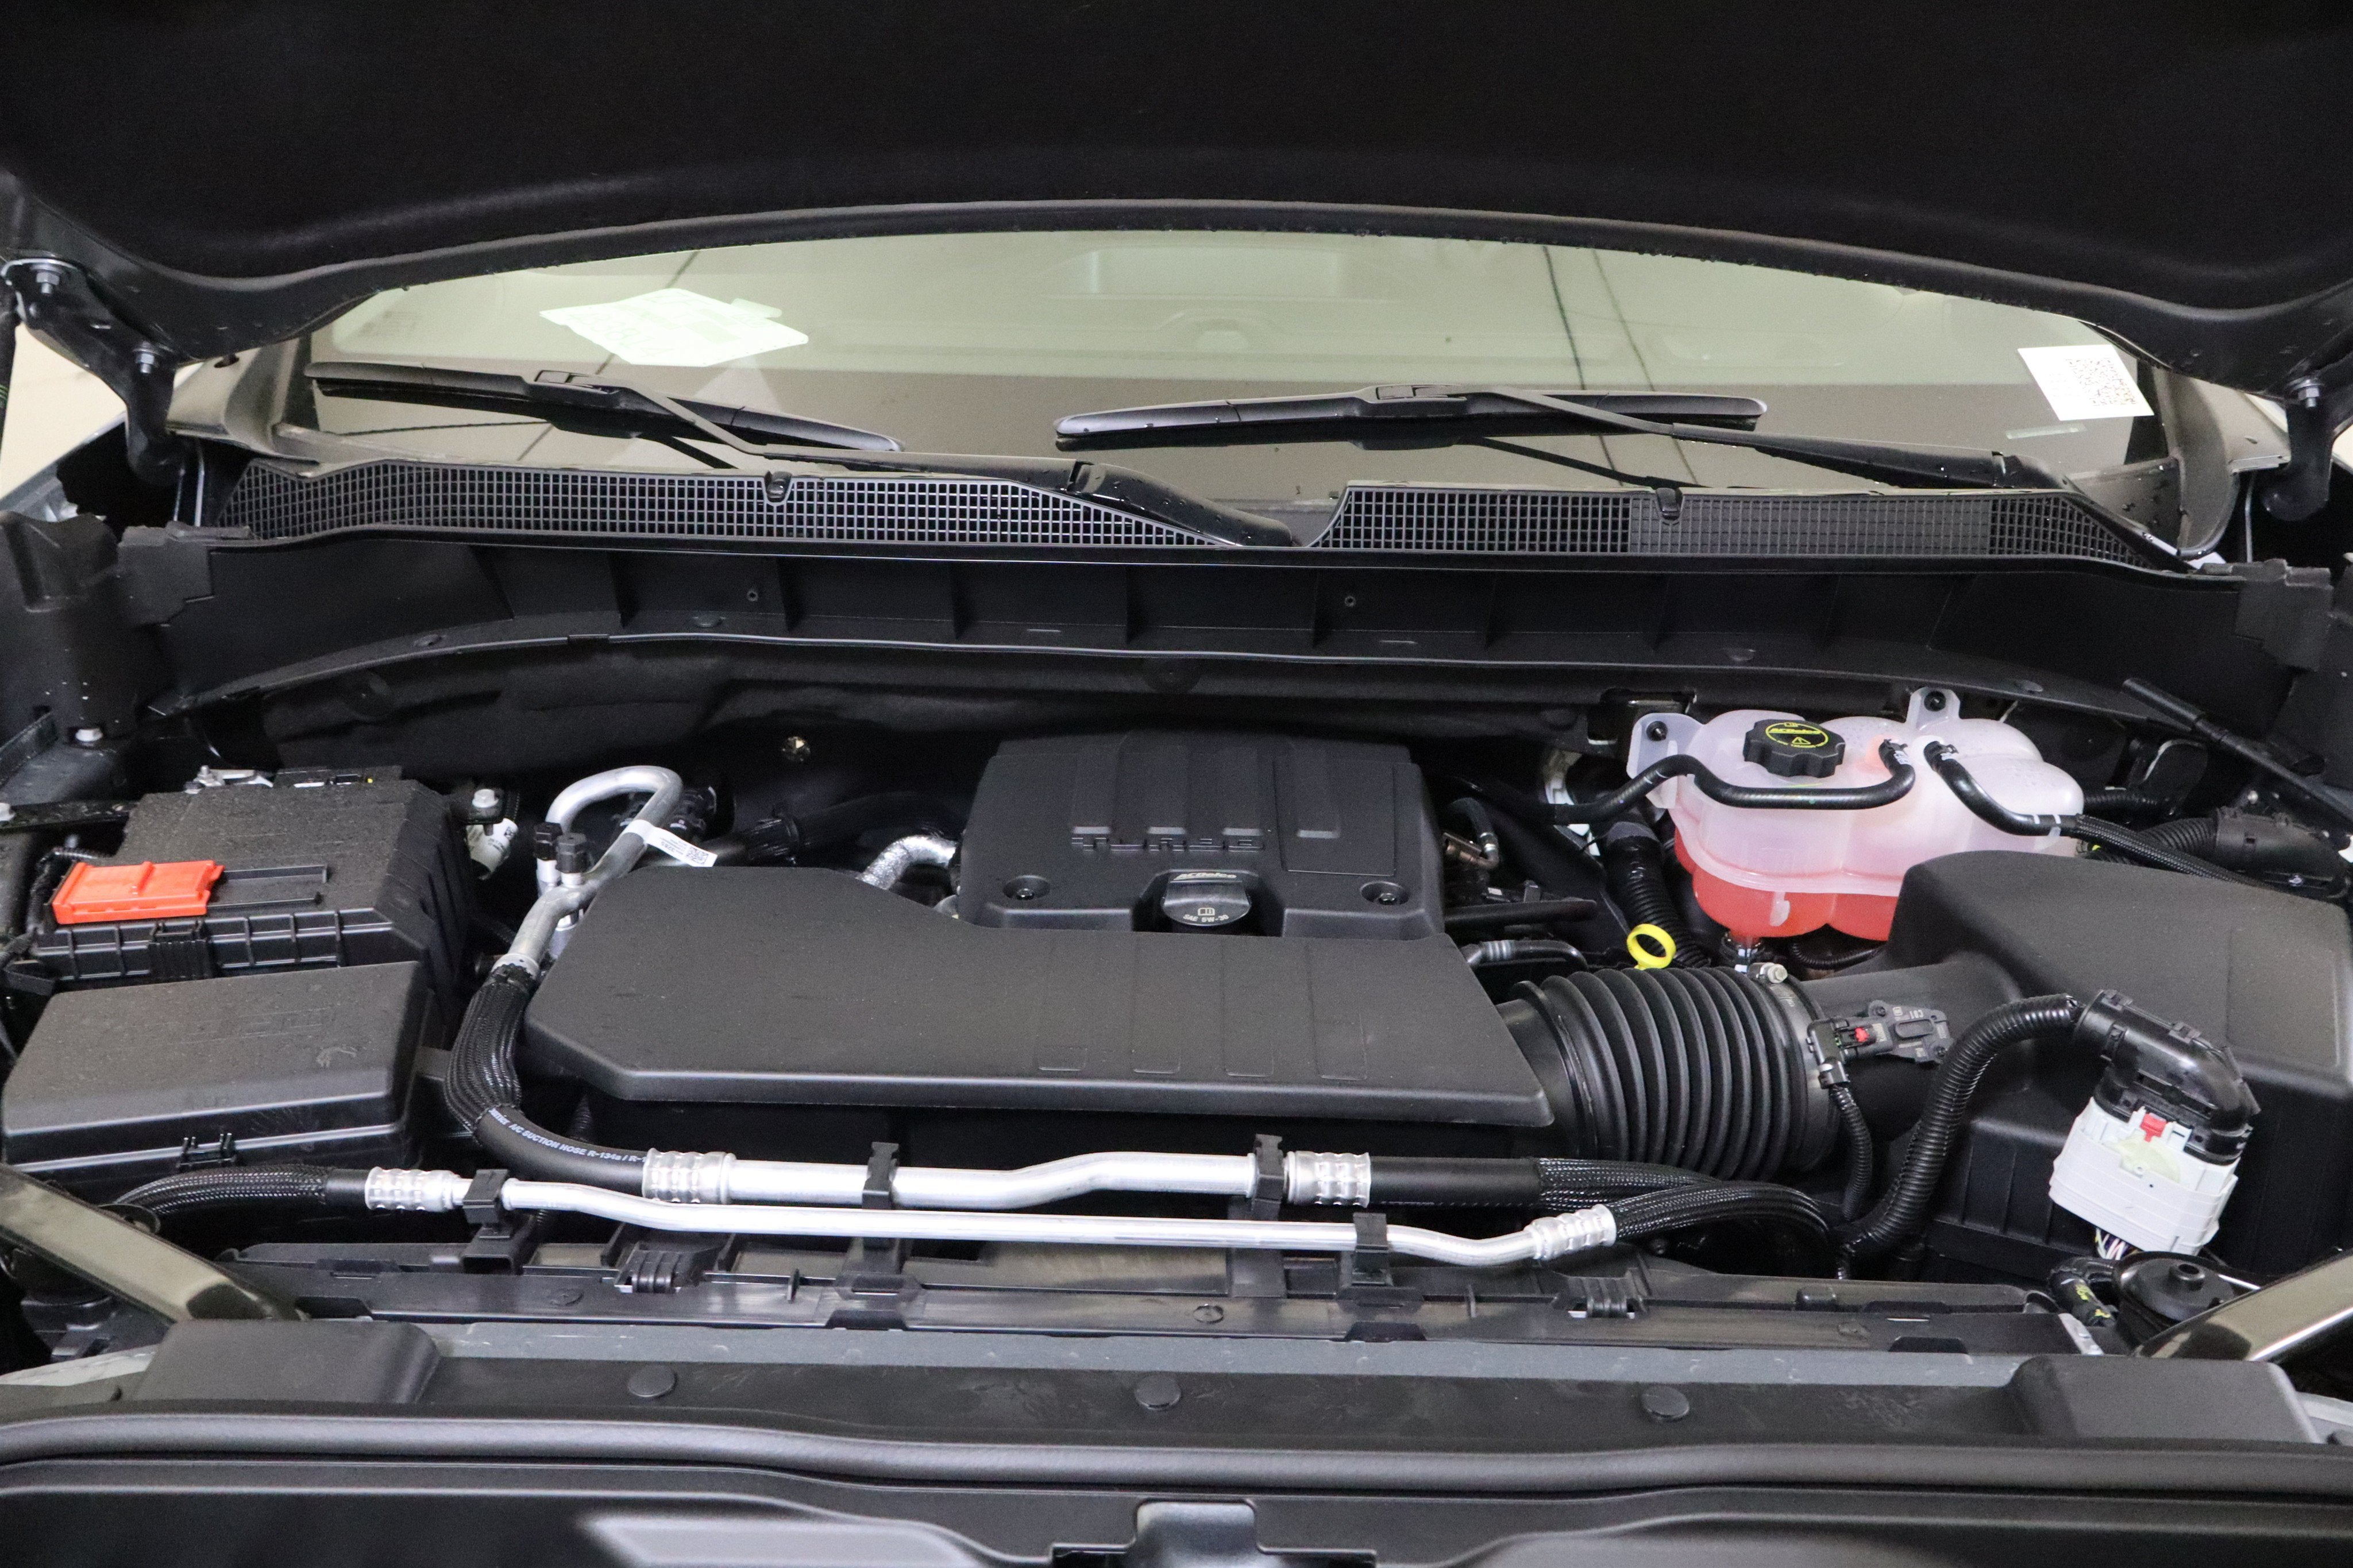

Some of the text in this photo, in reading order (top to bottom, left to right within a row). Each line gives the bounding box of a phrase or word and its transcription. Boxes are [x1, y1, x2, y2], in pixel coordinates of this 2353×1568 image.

[1173, 872, 1237, 880] ACDelco
[1201, 914, 1229, 922] 5W-30
[522, 1130, 560, 1149] SUCTION
[559, 1144, 587, 1155] HOSE
[587, 1150, 622, 1160] R-134a
